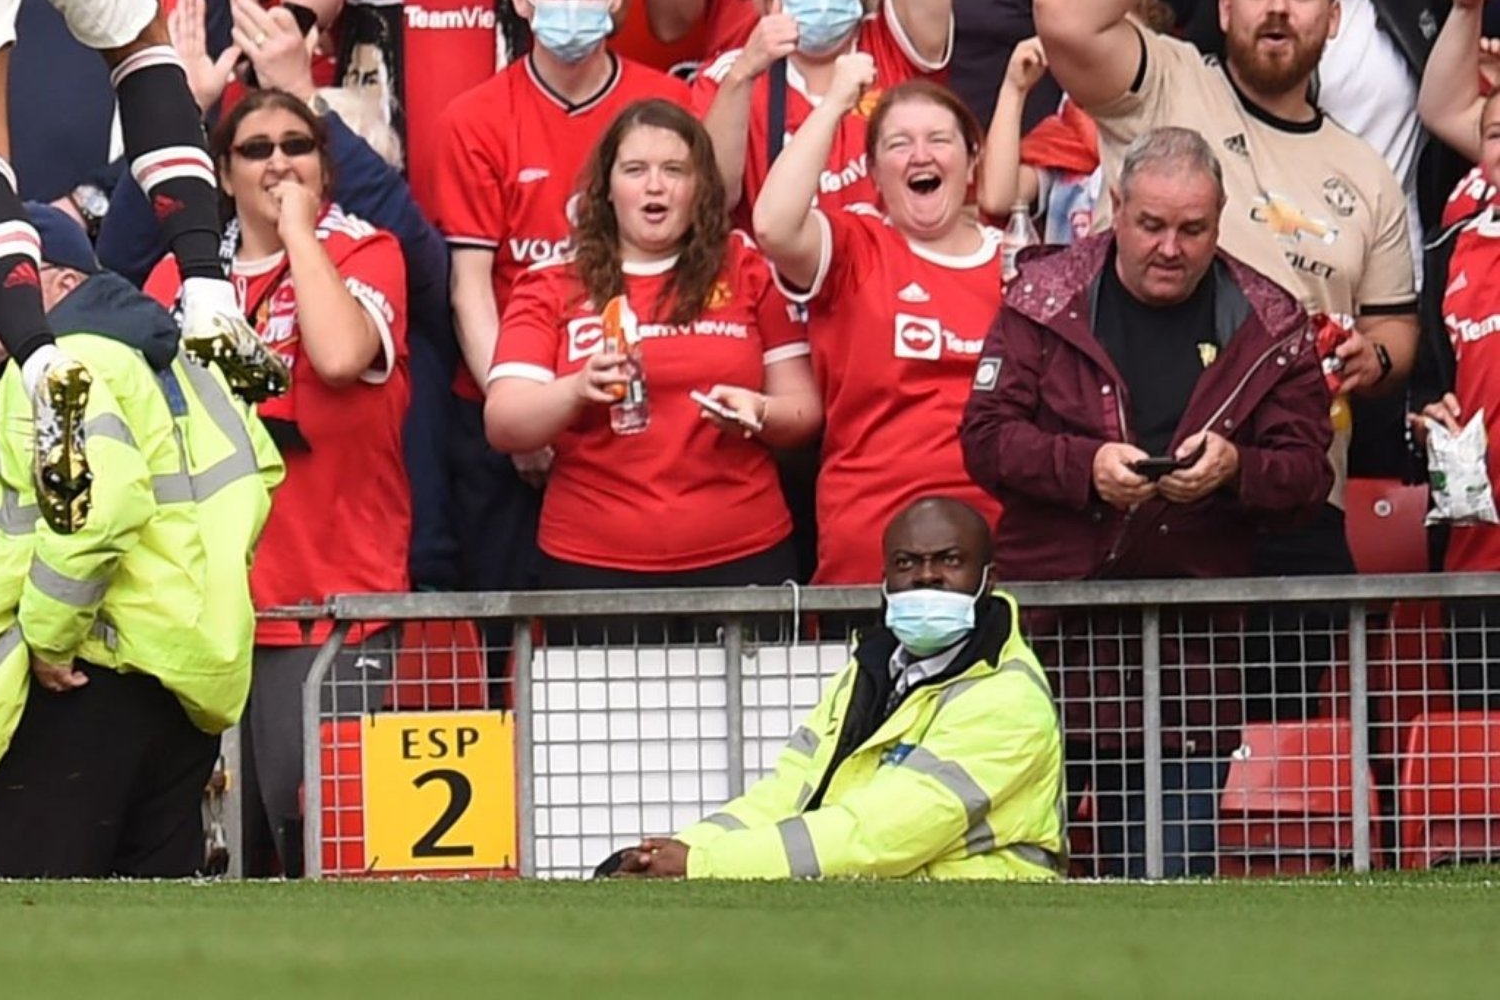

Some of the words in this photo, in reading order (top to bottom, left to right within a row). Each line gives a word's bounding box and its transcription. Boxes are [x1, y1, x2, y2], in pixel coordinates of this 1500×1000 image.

[404, 4, 497, 31] TeamVie
[402, 727, 480, 760] ESP
[411, 768, 475, 859] 2
